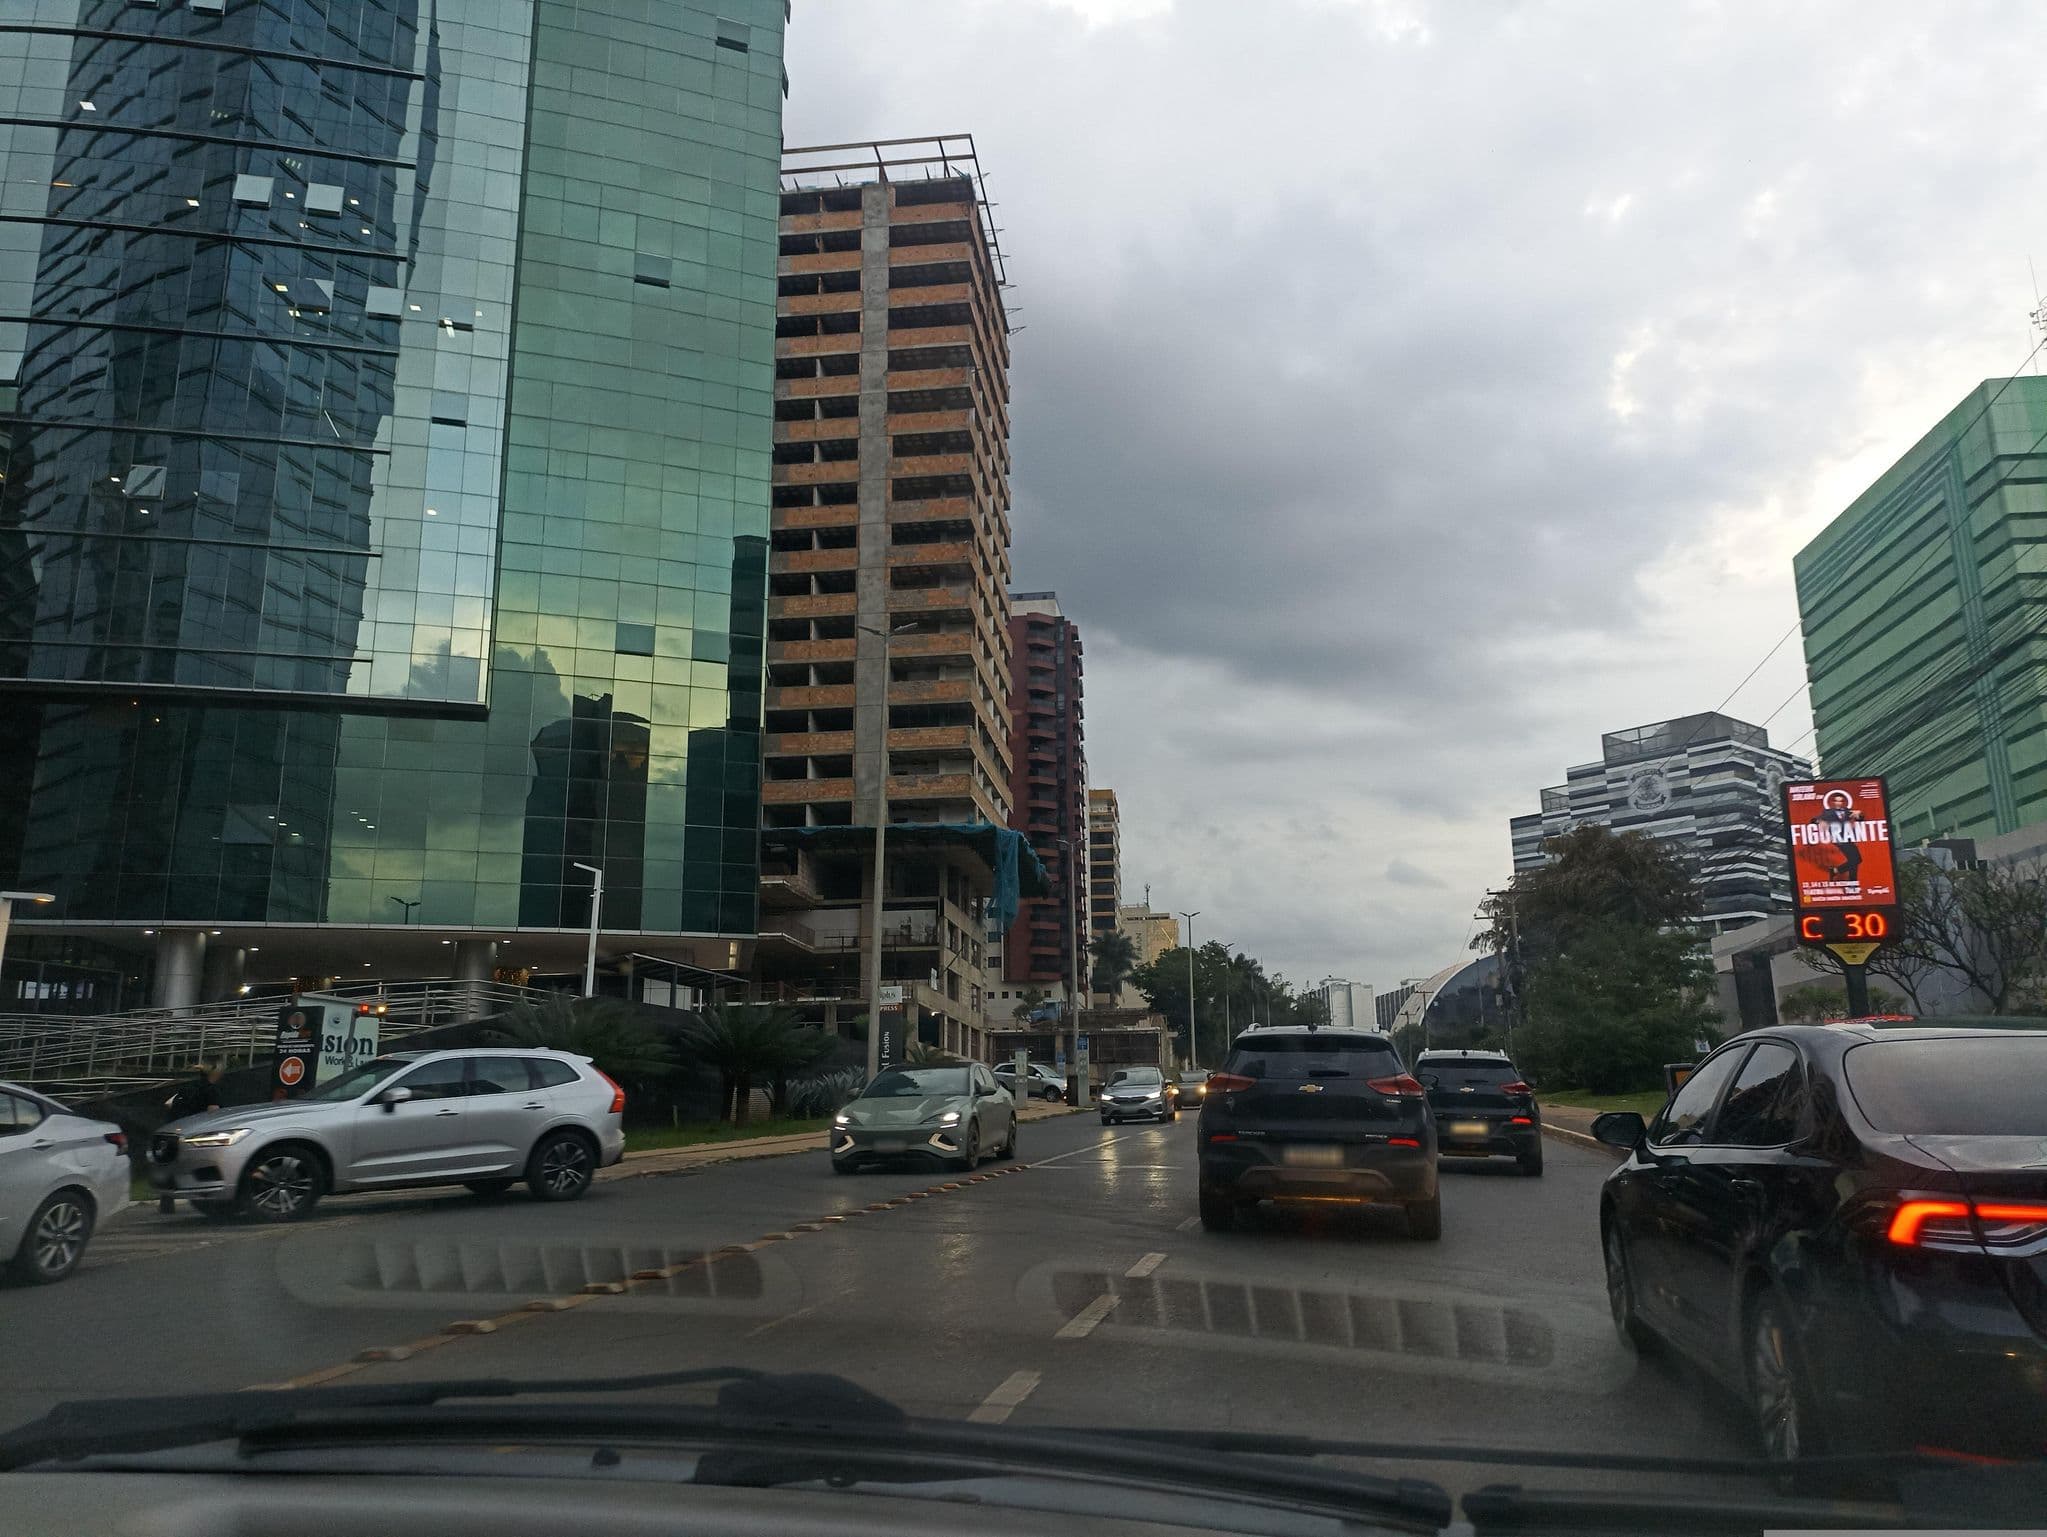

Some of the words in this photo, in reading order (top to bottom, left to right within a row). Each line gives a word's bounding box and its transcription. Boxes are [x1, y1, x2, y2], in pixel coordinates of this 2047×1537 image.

[1790, 820, 1889, 845] FIGURANTE
[1802, 916, 1823, 939] C
[1844, 913, 1886, 938] 30
